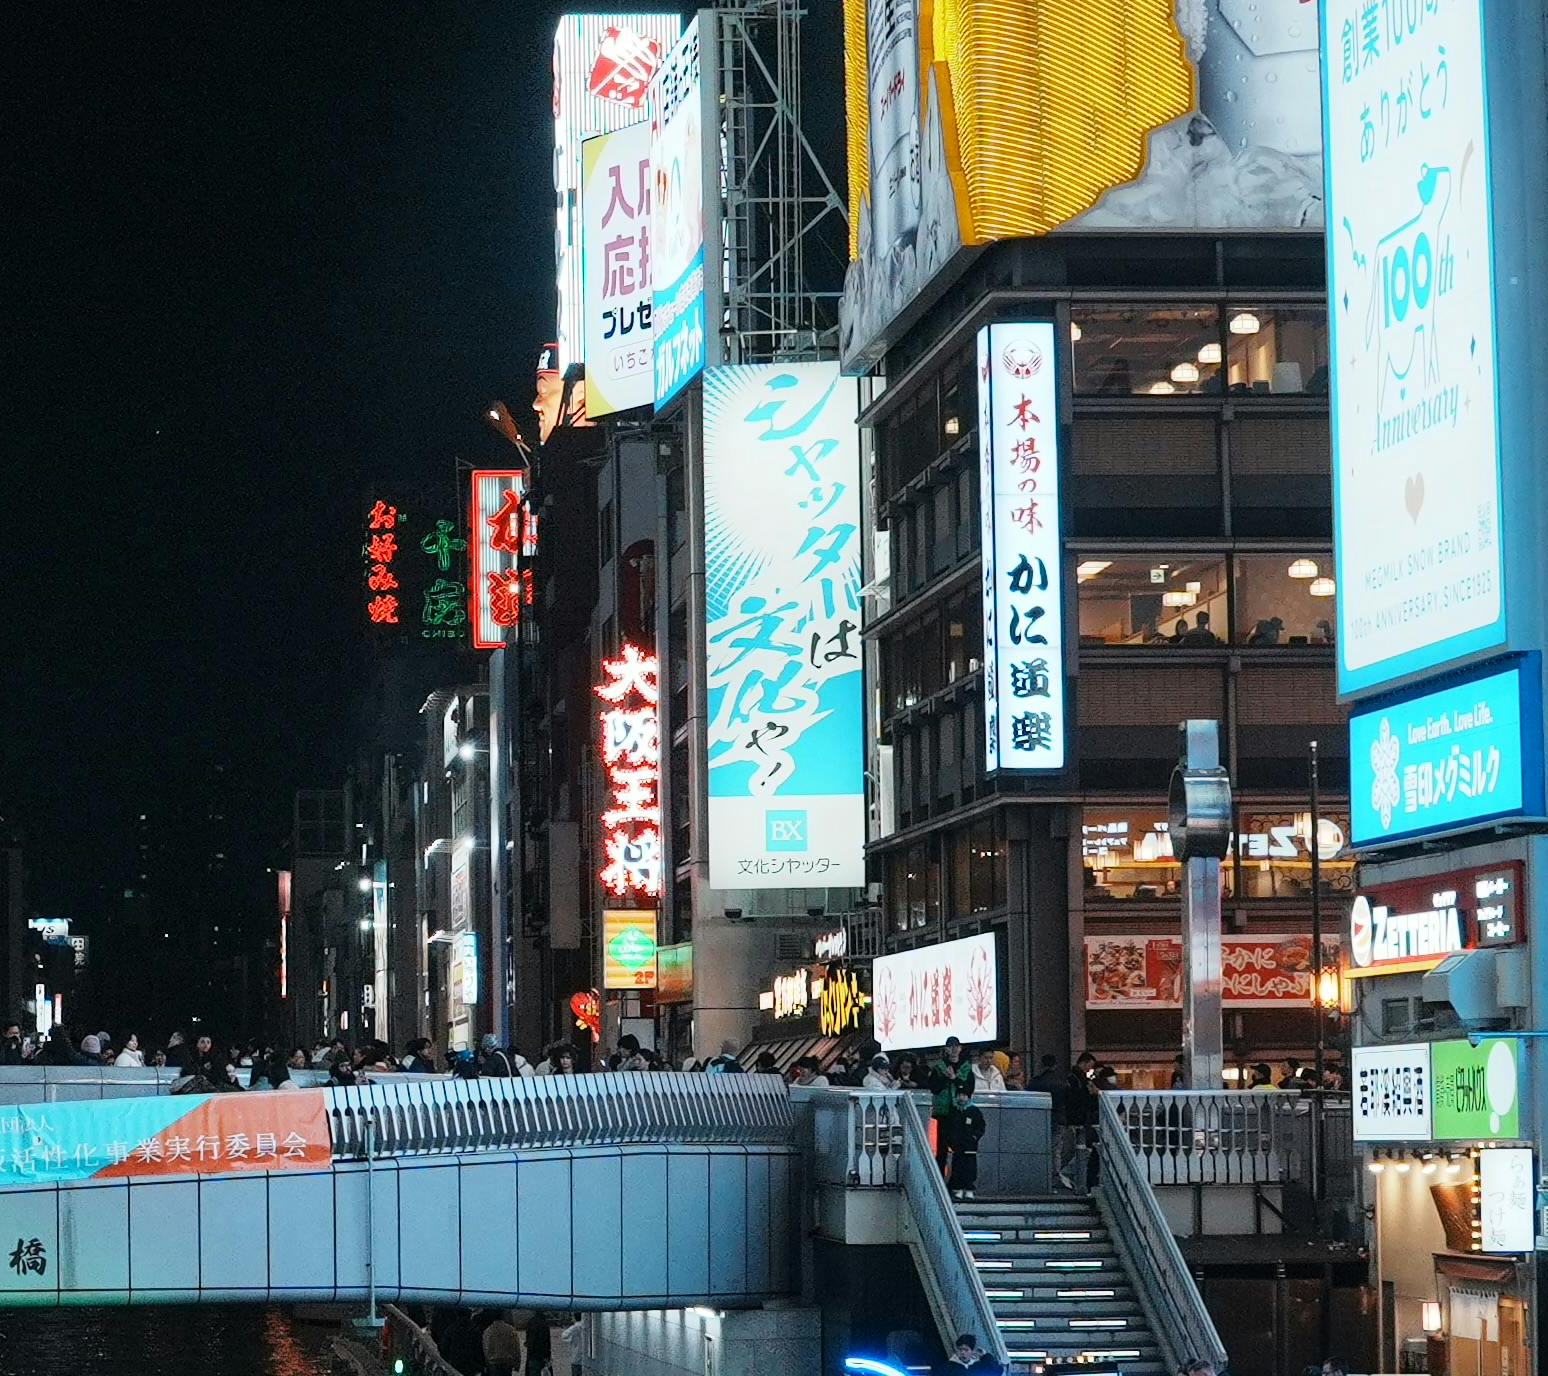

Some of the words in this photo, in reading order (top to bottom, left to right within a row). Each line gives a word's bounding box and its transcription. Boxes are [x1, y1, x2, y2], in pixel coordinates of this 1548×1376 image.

[1359, 44, 1449, 164] ありがとう
[1370, 382, 1459, 457] Anniversary
[1006, 390, 1046, 537] 本場の味
[367, 499, 400, 624] お好み焼
[1406, 547, 1437, 577] SNOW
[1438, 535, 1472, 566] BRAND
[1006, 552, 1052, 753] かに道楽
[1407, 721, 1427, 746] Love
[1453, 707, 1475, 734] Love
[593, 643, 664, 897] 大阪王将
[1402, 742, 1501, 814] 雪印メグミルク
[769, 819, 804, 842] BX
[1372, 904, 1463, 961] ZETTERIA
